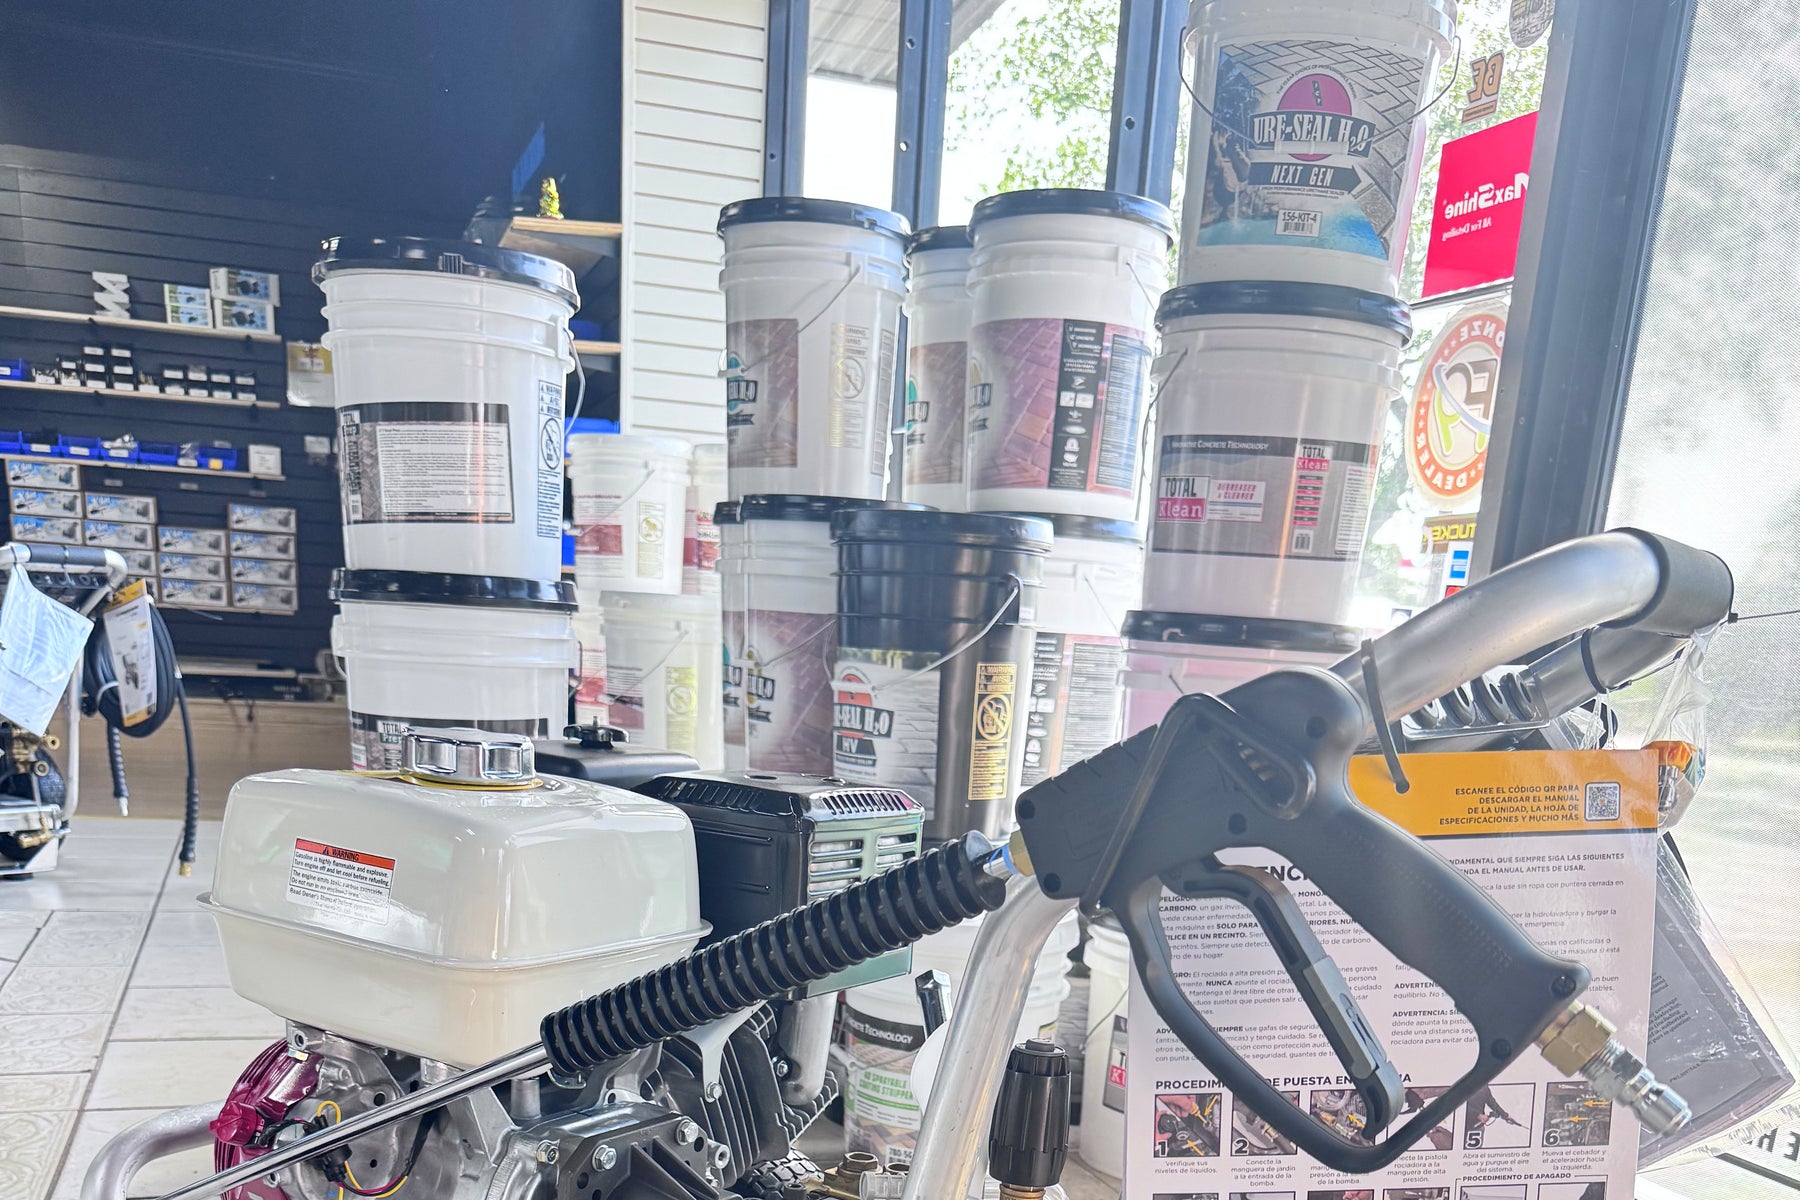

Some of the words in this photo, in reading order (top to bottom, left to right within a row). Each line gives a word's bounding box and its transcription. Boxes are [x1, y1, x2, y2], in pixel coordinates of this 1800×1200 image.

[1254, 112, 1332, 144] URE-SEAL
[1270, 165, 1300, 185] NEXT
[1309, 168, 1334, 186] GEN
[1282, 211, 1318, 223] 156-KIT-4
[1302, 446, 1326, 458] TOTAL
[1297, 460, 1329, 471] Klean
[1165, 478, 1197, 497] TOTAL
[1158, 501, 1202, 519] Klean
[1456, 787, 1494, 795] ESCANEE
[1508, 785, 1542, 794] CÓDIGO
[1479, 796, 1530, 804] DESCARGAR
[1494, 805, 1529, 814] UNIDAD,
[1440, 815, 1519, 825] ESPECIFICACIONES
[1529, 814, 1560, 822] MUCHO
[1560, 813, 1579, 821] MÁS
[296, 852, 313, 861] Gasoline
[319, 857, 332, 865] highly
[333, 860, 355, 870] flammable
[332, 849, 360, 861] WARNING
[302, 873, 316, 881] engine
[305, 862, 319, 870] engine
[353, 873, 368, 881] before
[864, 1024, 914, 1044] TECHNOLOGY
[872, 1073, 907, 1088] SPRAYABLE
[1156, 1079, 1225, 1089] PROCEDIM
[1284, 1076, 1332, 1086] PUESTA
[882, 1086, 913, 1099] STRIPPER
[1466, 1132, 1481, 1148] 5
[1545, 1129, 1559, 1145] 6
[1158, 1141, 1167, 1156] 1
[1234, 1139, 1248, 1154] 2
